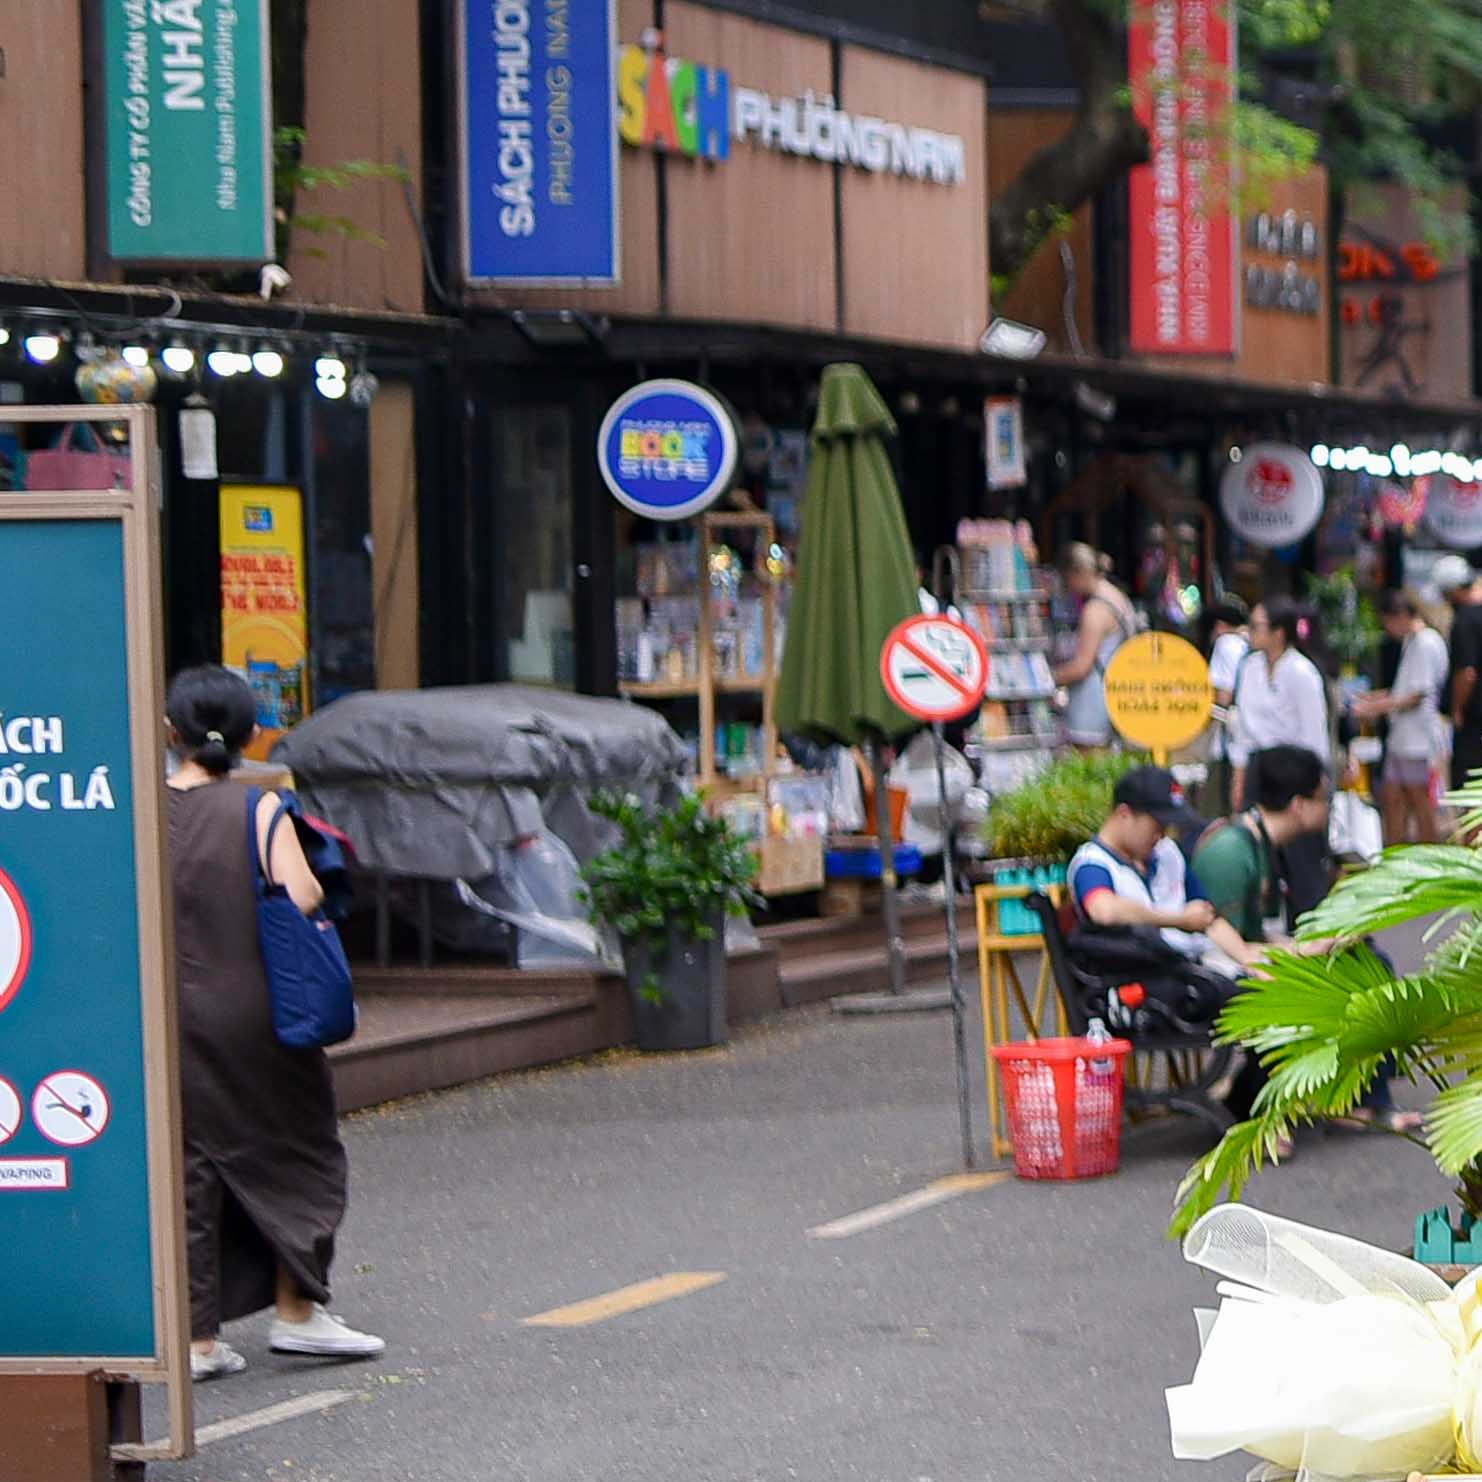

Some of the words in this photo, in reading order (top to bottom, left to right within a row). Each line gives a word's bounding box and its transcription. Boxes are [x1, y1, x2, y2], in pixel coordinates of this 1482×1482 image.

[491, 120, 536, 236] SÁCH
[621, 429, 709, 460] BOOK
[59, 765, 116, 810] LÁ
